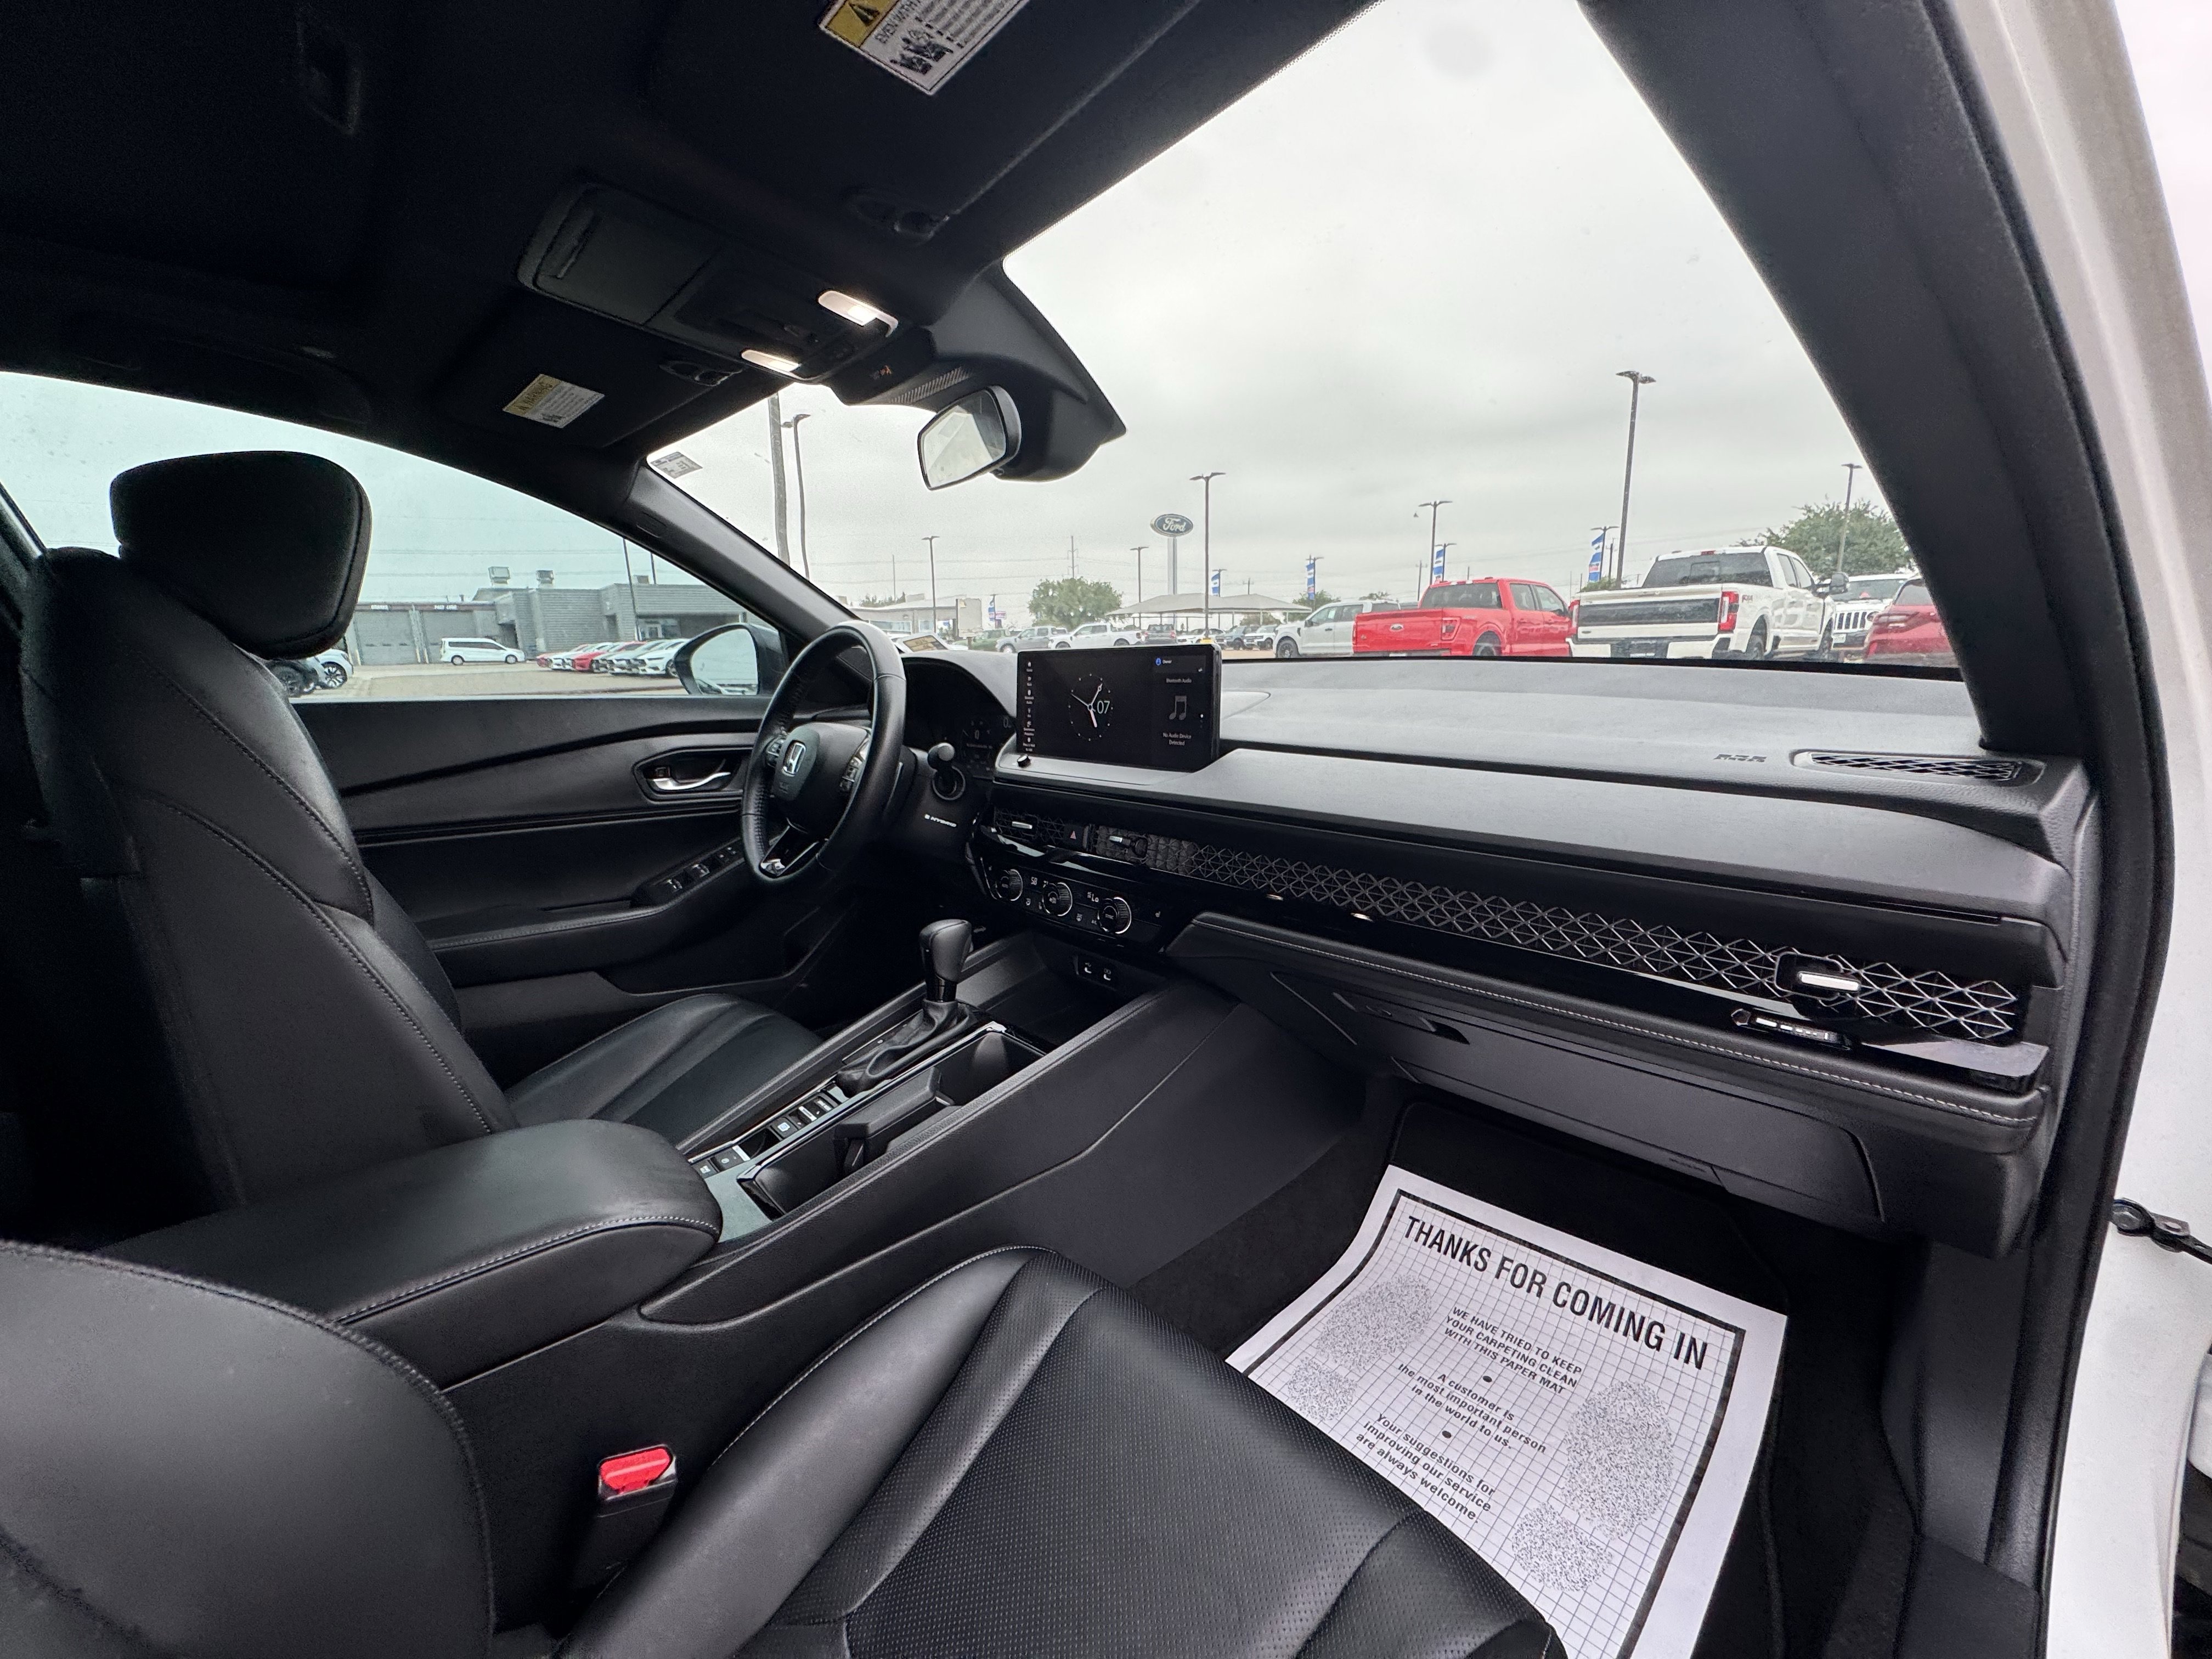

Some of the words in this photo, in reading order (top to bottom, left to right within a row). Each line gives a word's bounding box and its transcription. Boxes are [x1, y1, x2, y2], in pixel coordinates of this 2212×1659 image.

[1163, 517, 1187, 532] Ford
[1097, 701, 1110, 714] 07
[1403, 1216, 1492, 1272] THANKS
[1494, 1257, 1547, 1298] FOR
[1553, 1282, 1666, 1352] COMING
[1673, 1332, 1708, 1370] IN
[1444, 1328, 1471, 1346] WITH
[1474, 1342, 1498, 1361] THIS
[1499, 1356, 1537, 1380] PAPER
[1539, 1375, 1565, 1394] MAT
[1446, 1316, 1474, 1334] YOUR
[1476, 1331, 1537, 1368] CARPETING
[1539, 1362, 1578, 1387] CLEAN
[1453, 1307, 1469, 1319] WE
[1470, 1316, 1498, 1334] HAVE
[1502, 1330, 1532, 1351] TRIED
[1536, 1346, 1550, 1359] TO
[1552, 1354, 1582, 1375] KEEP
[1398, 1364, 1415, 1378] the
[1417, 1374, 1445, 1395] most
[1446, 1388, 1502, 1426] important
[1503, 1424, 1547, 1454] person
[1411, 1385, 1423, 1396] in
[1424, 1392, 1442, 1408] the
[1445, 1406, 1477, 1429] world
[1480, 1425, 1491, 1437] to
[1494, 1434, 1513, 1449] us.
[1437, 1374, 1447, 1382] A
[1448, 1379, 1503, 1413] customer
[1504, 1409, 1515, 1421] is
[1356, 1432, 1376, 1450] are
[1377, 1445, 1418, 1480] always
[1420, 1476, 1479, 1523] welcome.
[1364, 1421, 1420, 1465] improving
[1423, 1462, 1444, 1479] our
[1445, 1477, 1491, 1511] service
[1377, 1414, 1402, 1435] Your
[1403, 1432, 1475, 1482] suggestions
[1477, 1478, 1496, 1496] for
